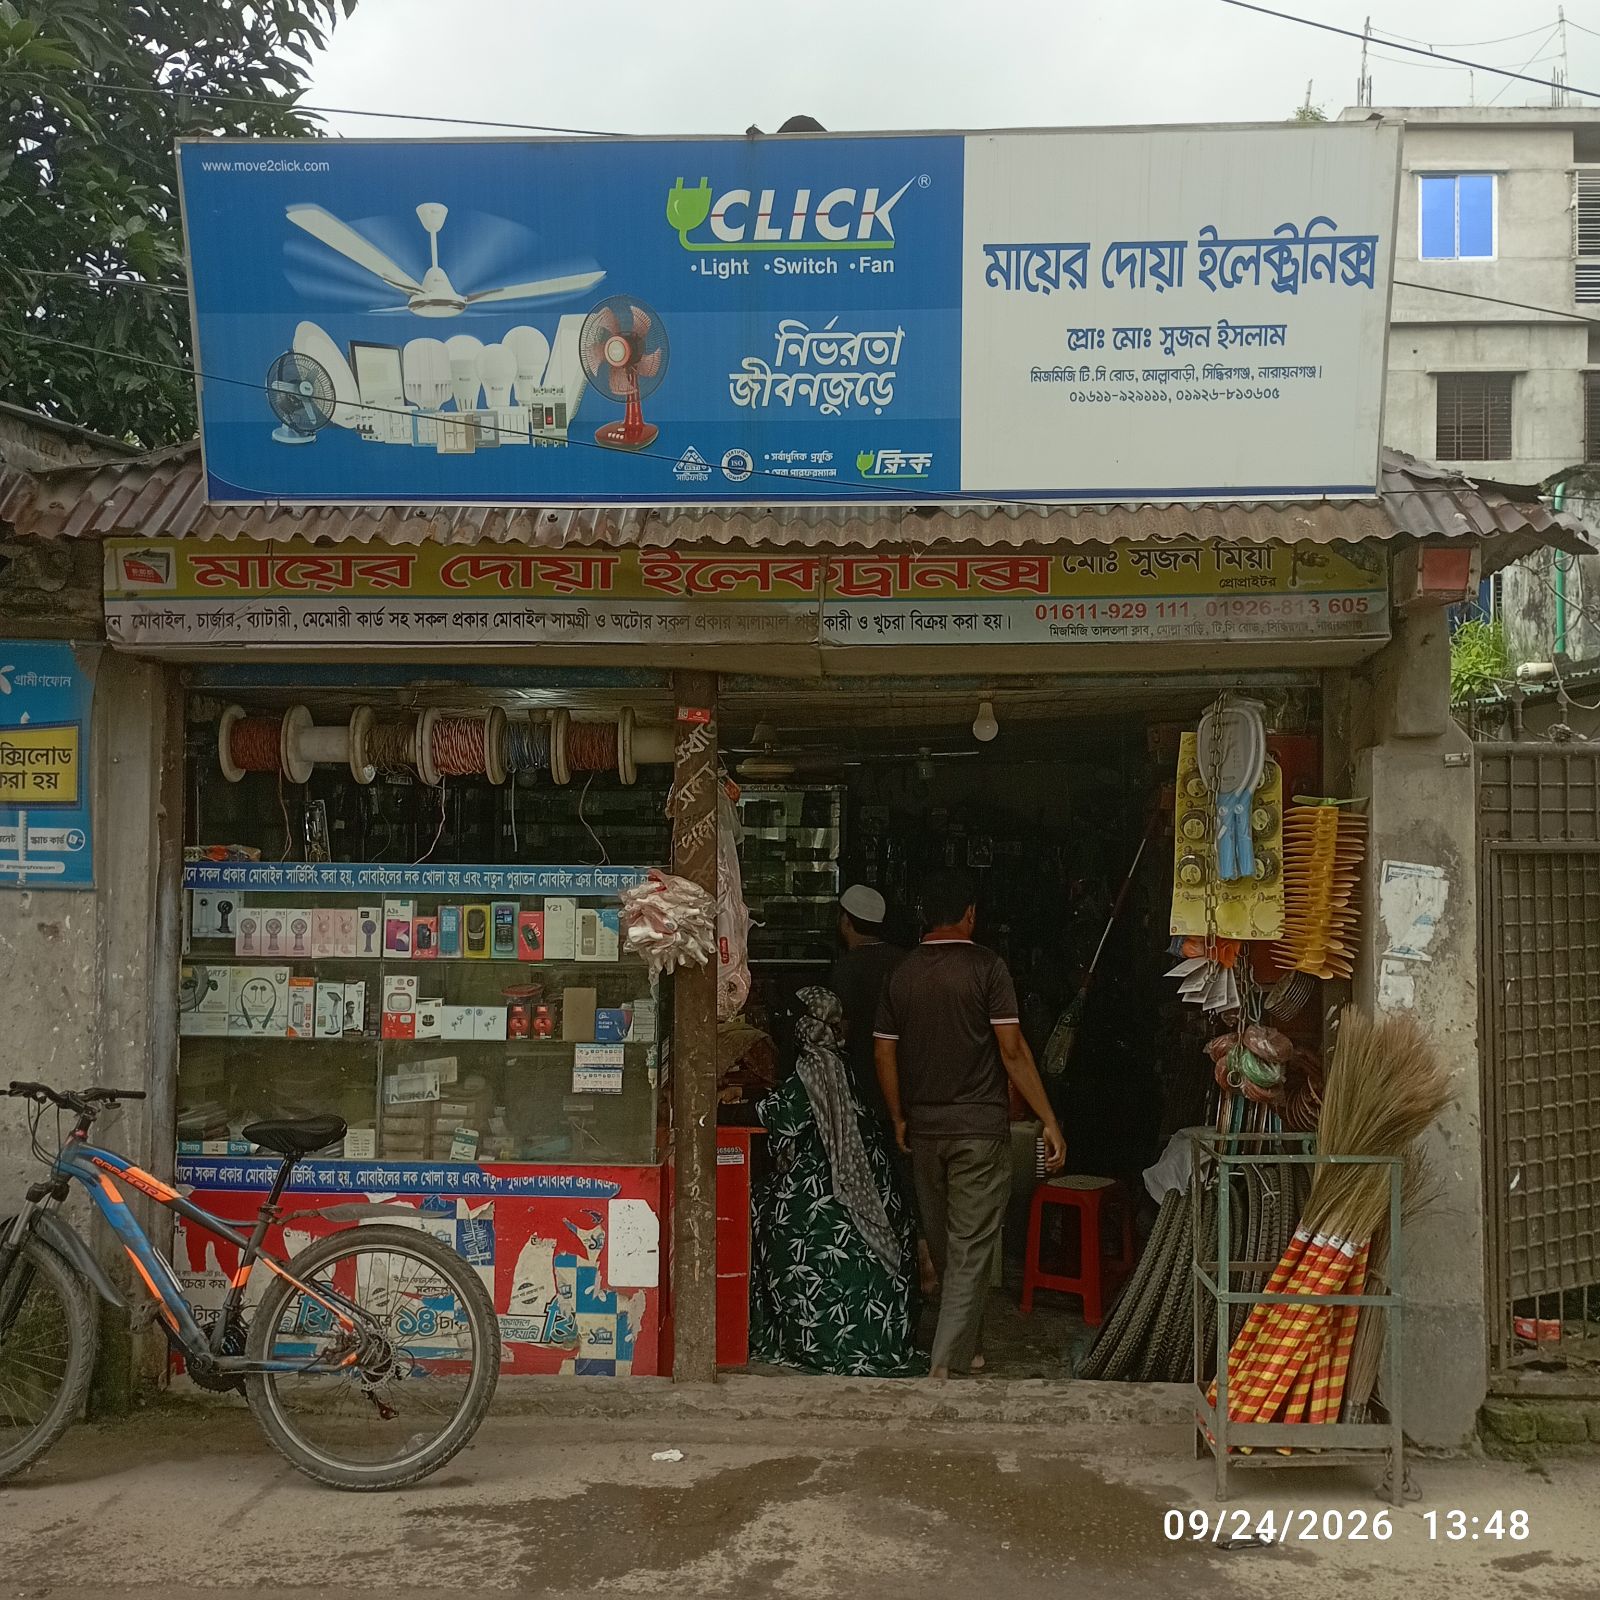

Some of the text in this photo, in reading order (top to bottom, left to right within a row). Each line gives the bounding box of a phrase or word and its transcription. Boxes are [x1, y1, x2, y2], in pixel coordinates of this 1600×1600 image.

[201, 159, 330, 173] www.move2click.com
[710, 175, 916, 242] CLICK
[701, 256, 895, 280] Light Switch Fan
[983, 242, 1091, 296] মায়ের
[1102, 240, 1188, 293] দোয়া
[774, 316, 905, 367] নির্ভরতা
[1113, 327, 1152, 351] মোঃ
[1159, 325, 1212, 356] সুজন
[1216, 319, 1287, 349] ইসলাম
[728, 356, 896, 416] জীবনজুড়ে
[1030, 366, 1076, 383] মিজমিজি
[1110, 369, 1139, 383] রোড,
[731, 459, 744, 467] ISO
[1126, 546, 1204, 578] সুজন
[1211, 541, 1276, 572] মিয়া
[188, 554, 417, 592] মায়ের
[440, 553, 621, 594] দোয়া
[1328, 597, 1369, 614] 605
[131, 608, 192, 634] মোবাইল,
[197, 609, 242, 632] চার্জার,
[247, 605, 298, 632] ব্যাটারী,
[302, 606, 351, 630] মেমোরী
[356, 606, 386, 629] কার্ড
[389, 612, 410, 630] সহ
[414, 612, 448, 630] সকল
[452, 612, 489, 631] প্রকার
[493, 607, 547, 630] মোবাইল
[551, 607, 591, 630] সামগ্রী
[595, 614, 607, 630] ও
[610, 610, 652, 631] অটোর
[656, 613, 691, 632] সকল
[857, 615, 868, 631] ও
[873, 612, 905, 635] খুচরা
[910, 609, 949, 632] বিক্রয়
[952, 612, 978, 631] করা
[1049, 623, 1088, 637] মিজমিজি
[14, 668, 72, 687] গ্রামীণফোন
[32, 771, 60, 791] হয়
[199, 867, 221, 882] সকল
[222, 868, 247, 883] প্রকার
[249, 866, 284, 885] মোবাইল
[320, 869, 338, 884] করা
[358, 867, 403, 886] মোবাইলের
[405, 870, 420, 885] লক
[422, 871, 445, 887] খোলা
[448, 872, 461, 889] হয়
[463, 872, 481, 888] এবং
[483, 872, 504, 890] নতুন
[506, 873, 535, 891] পুরাতন
[538, 868, 573, 889] মোবাইল
[594, 869, 619, 888] বিক্রয়
[621, 872, 637, 888] করা
[195, 1167, 217, 1184] সকল
[219, 1167, 243, 1184] প্রকার
[318, 1169, 335, 1184] করা
[356, 1166, 401, 1188] মোবাইলের
[403, 1171, 419, 1186] লক
[421, 1170, 445, 1187] খোলা
[446, 1171, 460, 1189] হয়
[462, 1171, 480, 1188] এবং
[209, 1279, 227, 1289] কম
[193, 1305, 222, 1322] টাক
